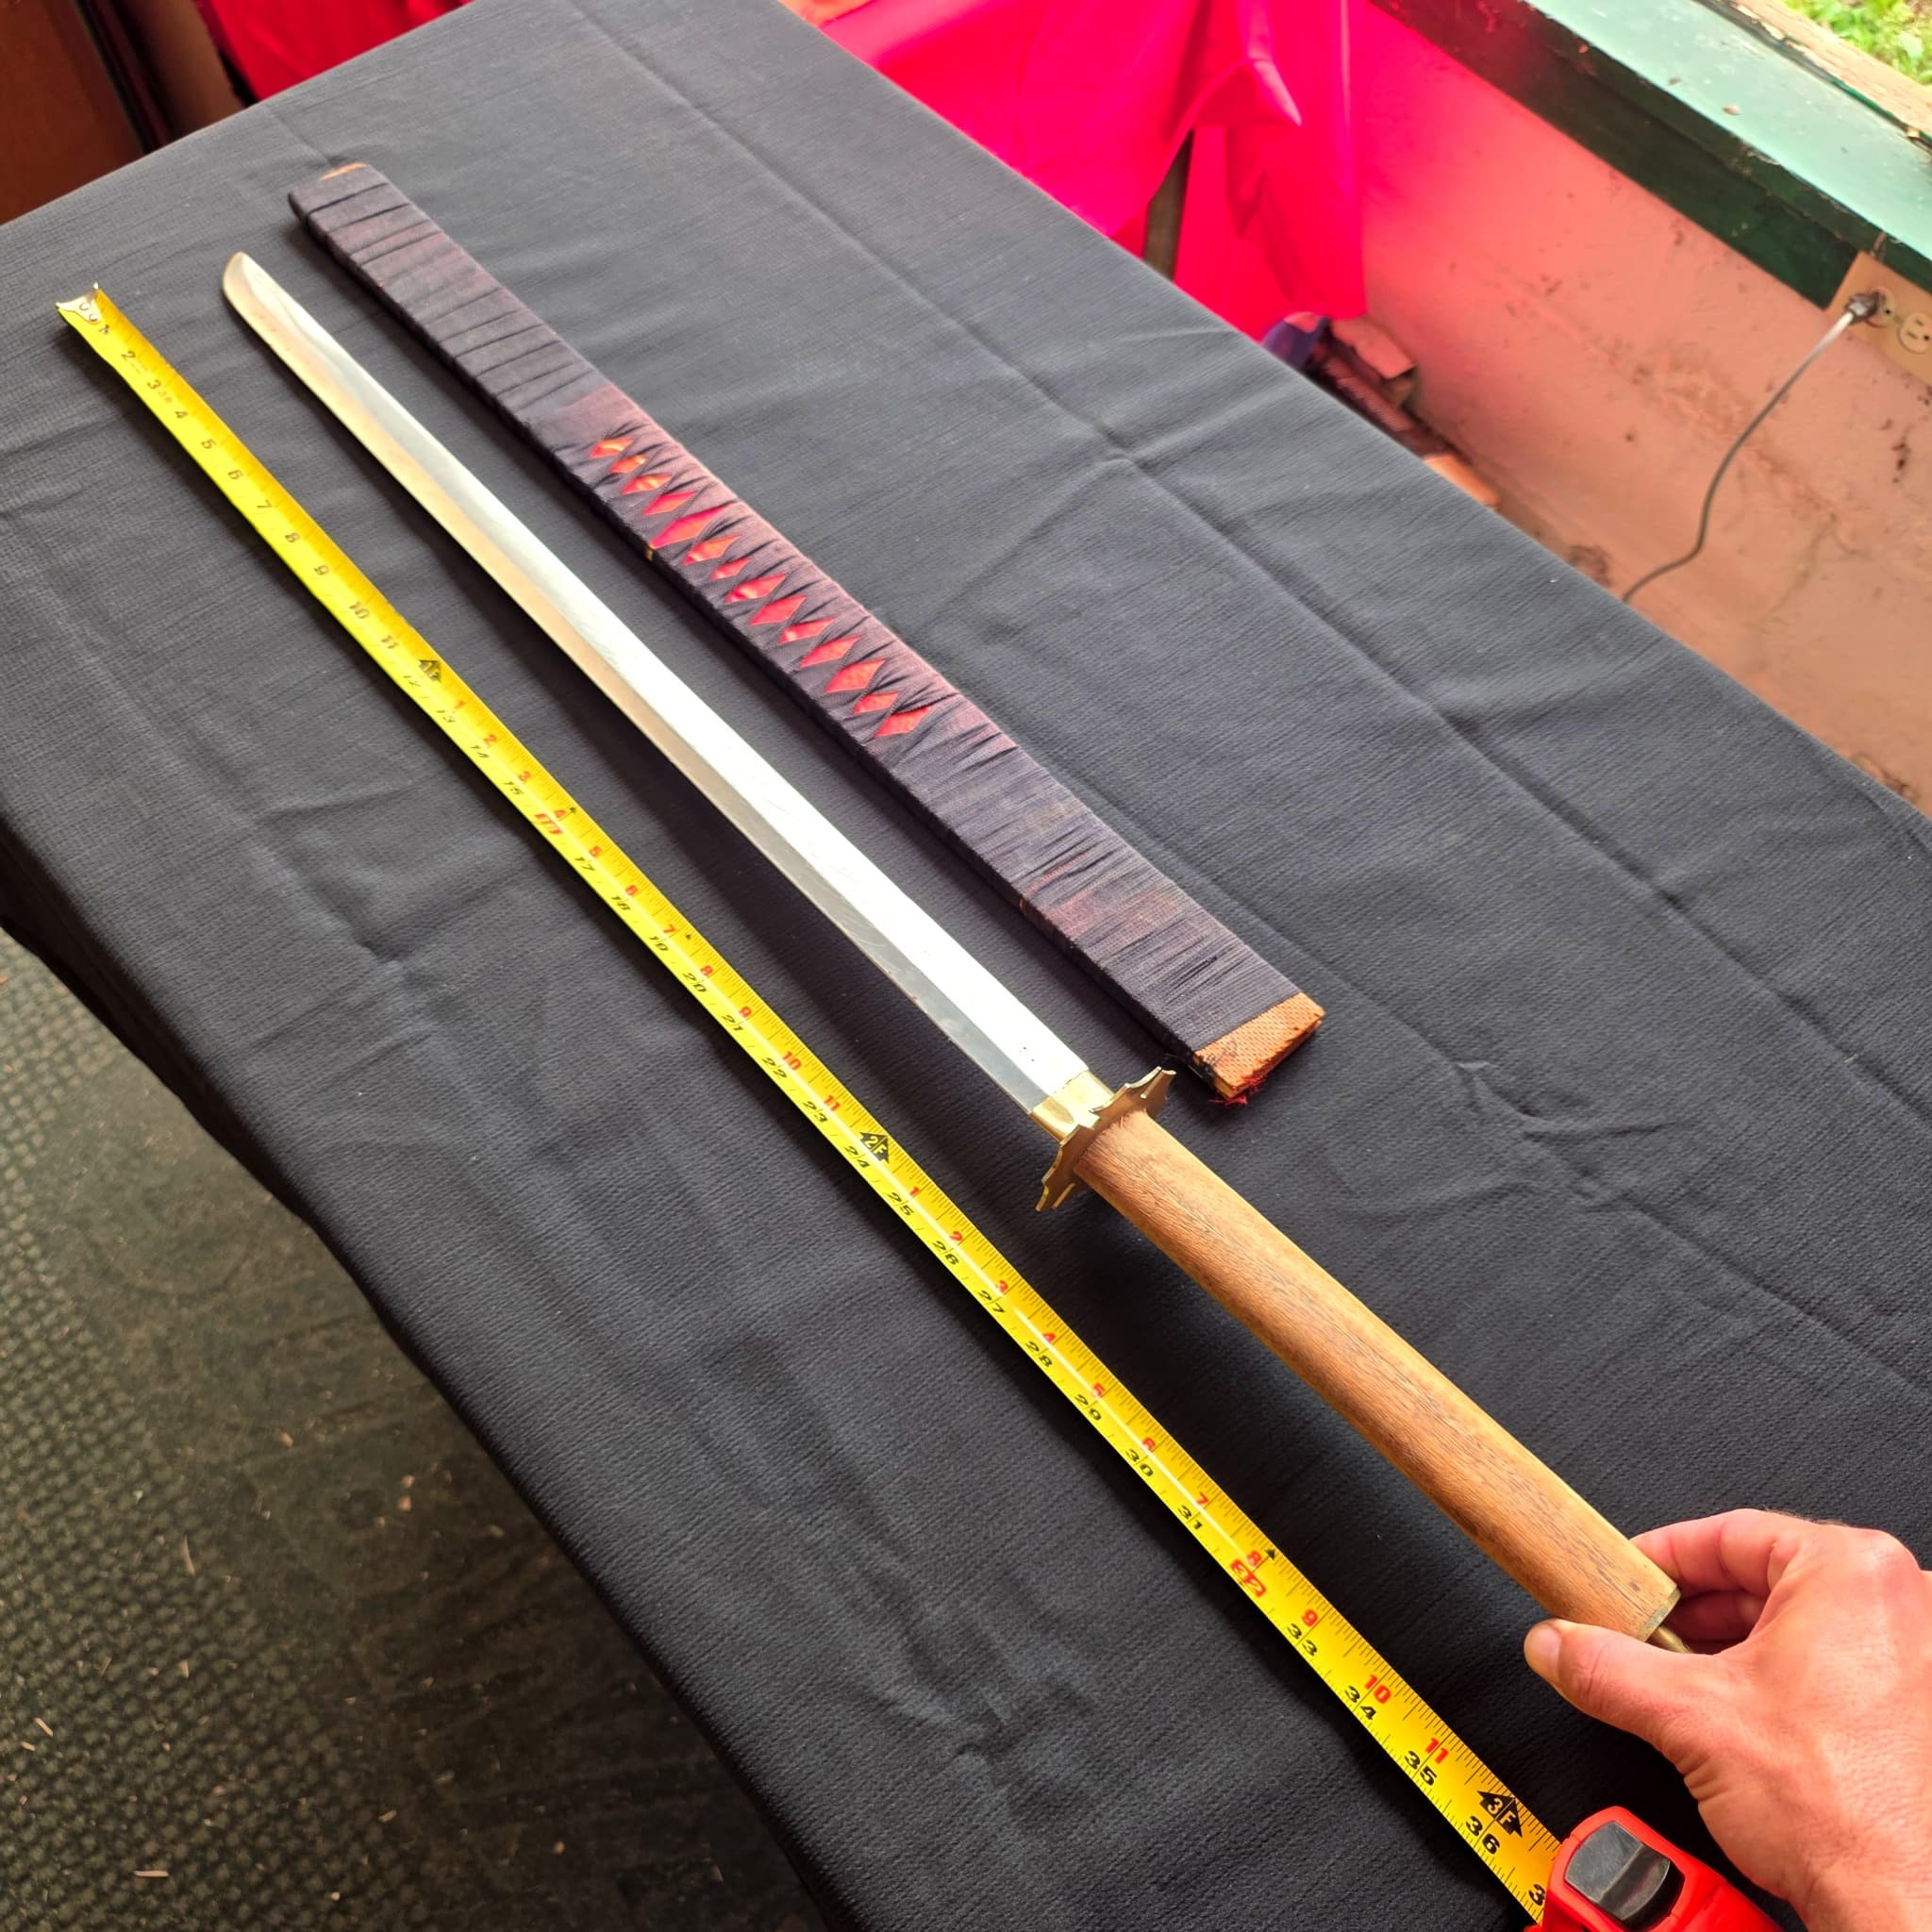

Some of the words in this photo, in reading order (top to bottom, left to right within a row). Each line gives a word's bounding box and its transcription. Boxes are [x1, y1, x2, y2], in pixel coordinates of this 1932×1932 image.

[121, 350, 136, 361] 2
[147, 379, 161, 390] 3
[175, 409, 189, 419] 4
[202, 439, 216, 450] 5
[228, 470, 243, 480] 6
[257, 499, 272, 510] 7
[285, 532, 301, 543] 8
[314, 564, 329, 575] 9
[349, 601, 370, 620] 10
[381, 635, 399, 649] 11
[436, 709, 456, 723] 13
[483, 734, 497, 745] 2
[470, 745, 490, 758] 14
[519, 771, 531, 783] 3
[504, 781, 525, 795] 15
[575, 857, 595, 872] 17
[611, 896, 631, 910] 18
[664, 924, 676, 934] 7
[649, 936, 669, 952] 19
[700, 965, 713, 975] 8
[682, 973, 707, 992] 20
[740, 1006, 752, 1018] 9
[722, 1014, 744, 1032] 21
[762, 1058, 787, 1078] 22
[783, 1051, 802, 1070] 10
[824, 1094, 841, 1111] 11
[804, 1101, 828, 1123] 23
[865, 1135, 888, 1155] 2F
[844, 1145, 871, 1168] 24
[909, 1187, 920, 1196] 1
[888, 1192, 914, 1216] 25
[950, 1231, 963, 1241] 2
[932, 1241, 959, 1265] 26
[996, 1280, 1008, 1292] 3
[978, 1291, 1005, 1313] 27
[1042, 1333, 1056, 1343] 4
[1025, 1341, 1053, 1368] 28
[1091, 1383, 1105, 1398] 5
[1075, 1394, 1102, 1421] 29
[1125, 1449, 1154, 1476] 30
[1196, 1491, 1208, 1506] 7
[1177, 1506, 1203, 1530] 31
[1246, 1550, 1262, 1567] 8
[1230, 1559, 1266, 1597] 32
[1301, 1609, 1318, 1626] 9
[1287, 1624, 1318, 1656] 33
[1364, 1674, 1391, 1704] 10
[1344, 1686, 1376, 1721] 34
[1425, 1738, 1449, 1764] 11
[1405, 1751, 1438, 1786] 35
[1488, 1798, 1516, 1824] 3F
[1466, 1816, 1501, 1855] 36
[1529, 1884, 1546, 1907] 3
